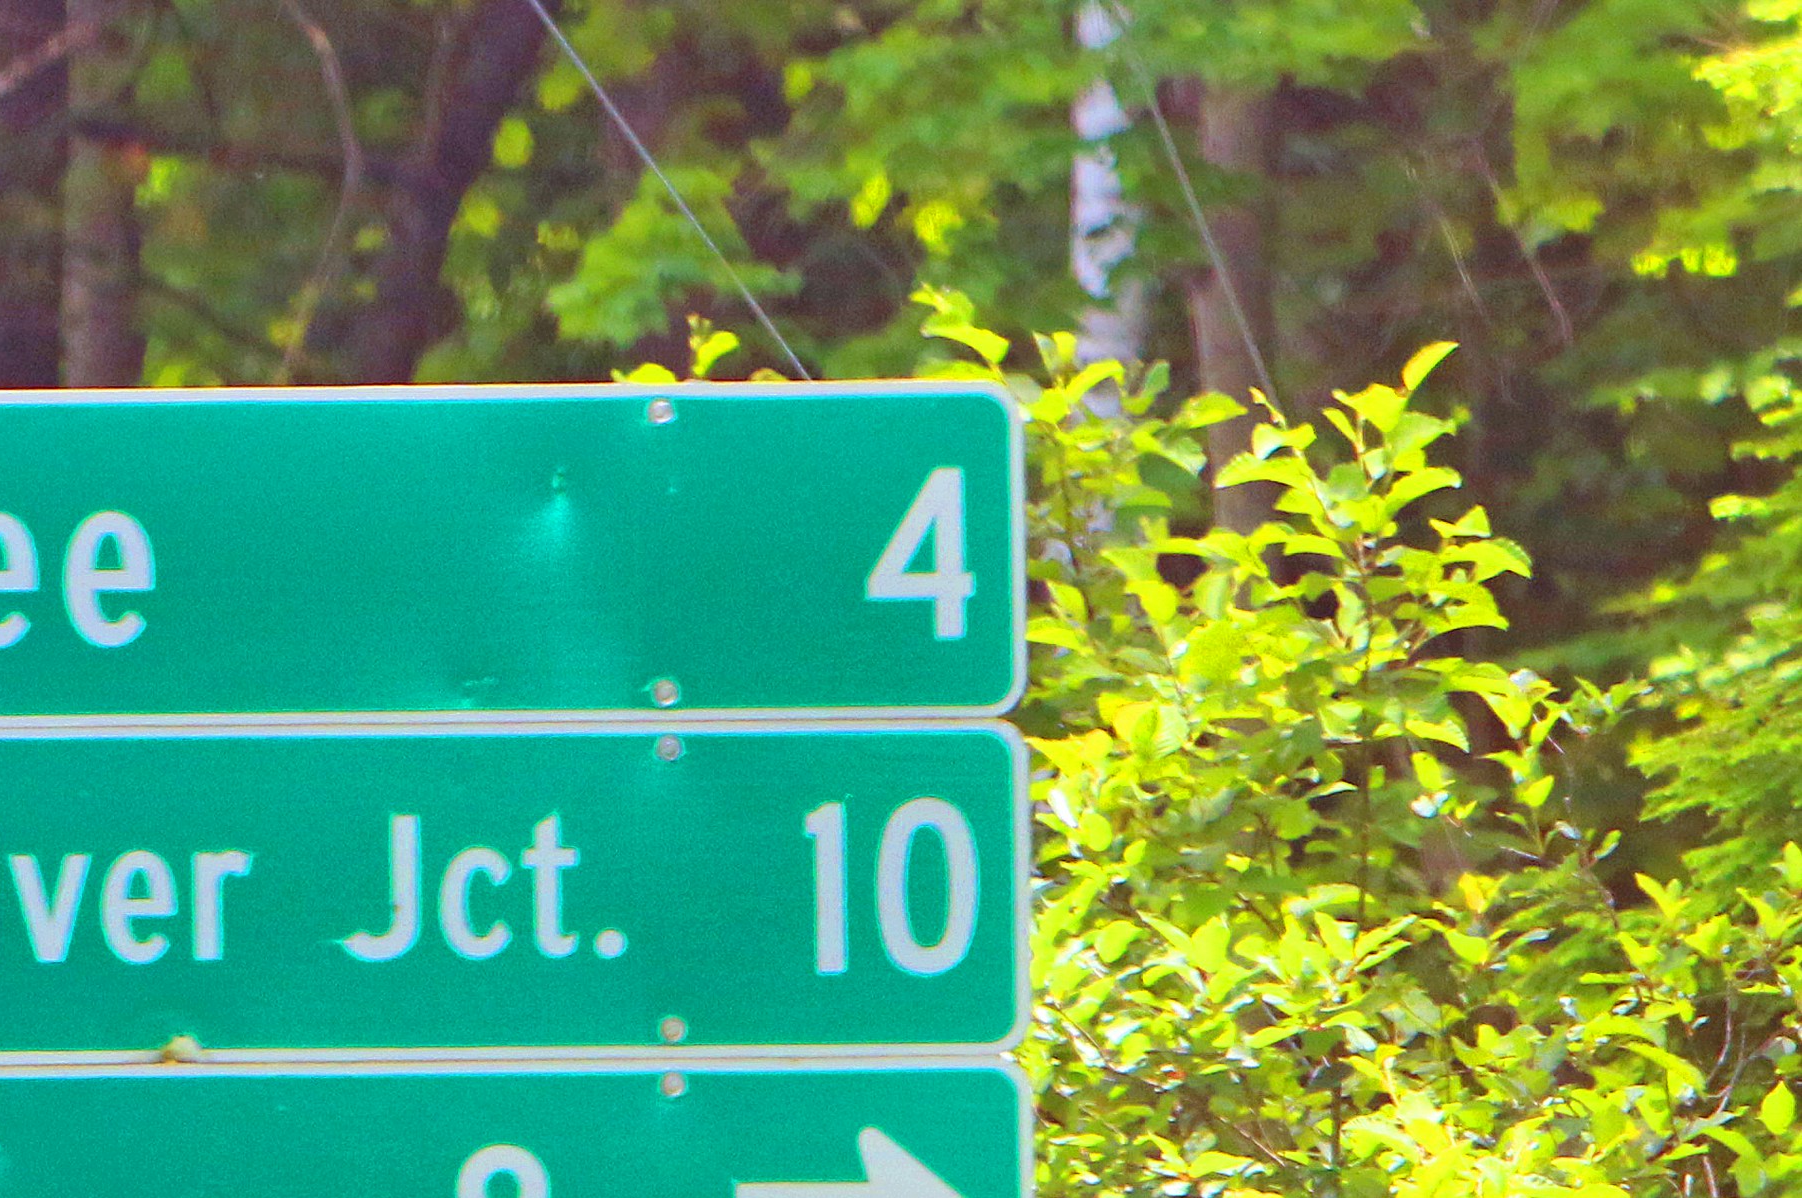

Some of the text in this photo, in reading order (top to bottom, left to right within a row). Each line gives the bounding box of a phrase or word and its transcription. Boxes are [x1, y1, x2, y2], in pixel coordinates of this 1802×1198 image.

[865, 465, 976, 639] 4
[341, 813, 626, 961] Jct.
[803, 796, 978, 975] 10
